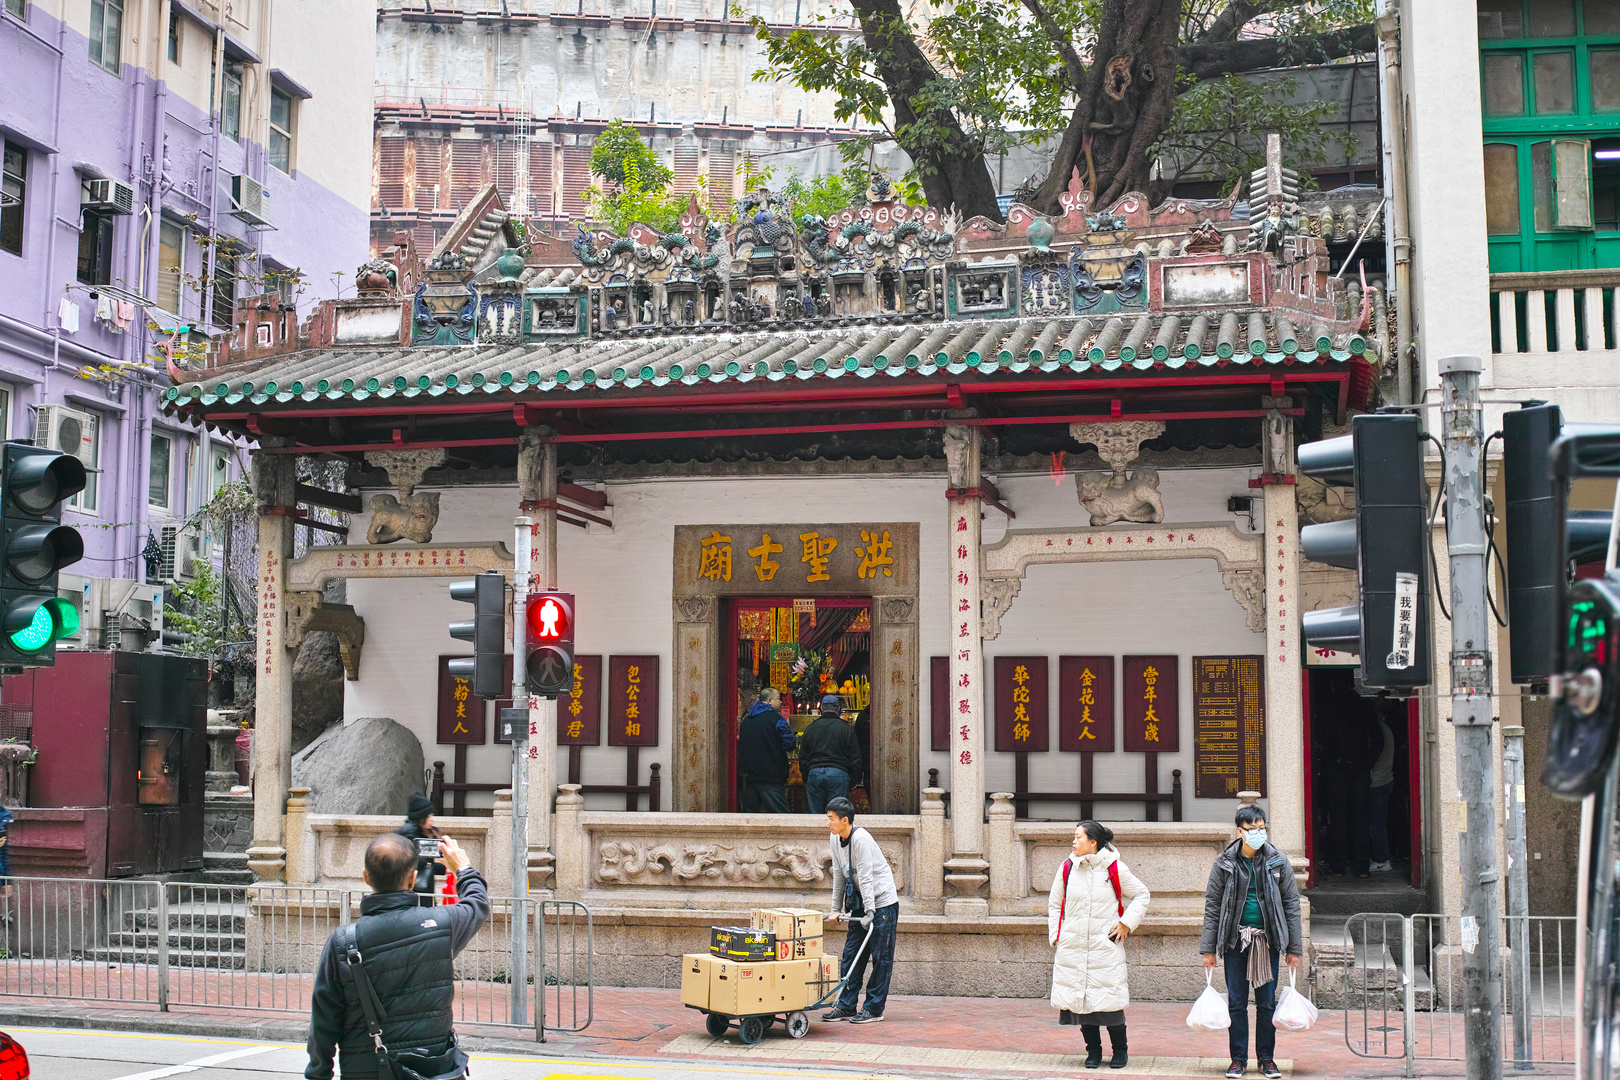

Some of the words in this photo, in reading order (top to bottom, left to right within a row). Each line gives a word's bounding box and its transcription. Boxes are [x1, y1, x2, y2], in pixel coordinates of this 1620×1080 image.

[697, 530, 894, 583] 洪聖古廟
[625, 665, 641, 737] 包公丞相
[1012, 665, 1032, 743] 華陀先師
[1078, 667, 1097, 741] 金花夫人
[1142, 665, 1160, 743] 當年太歲
[694, 959, 699, 967] 3
[721, 965, 726, 973] 3
